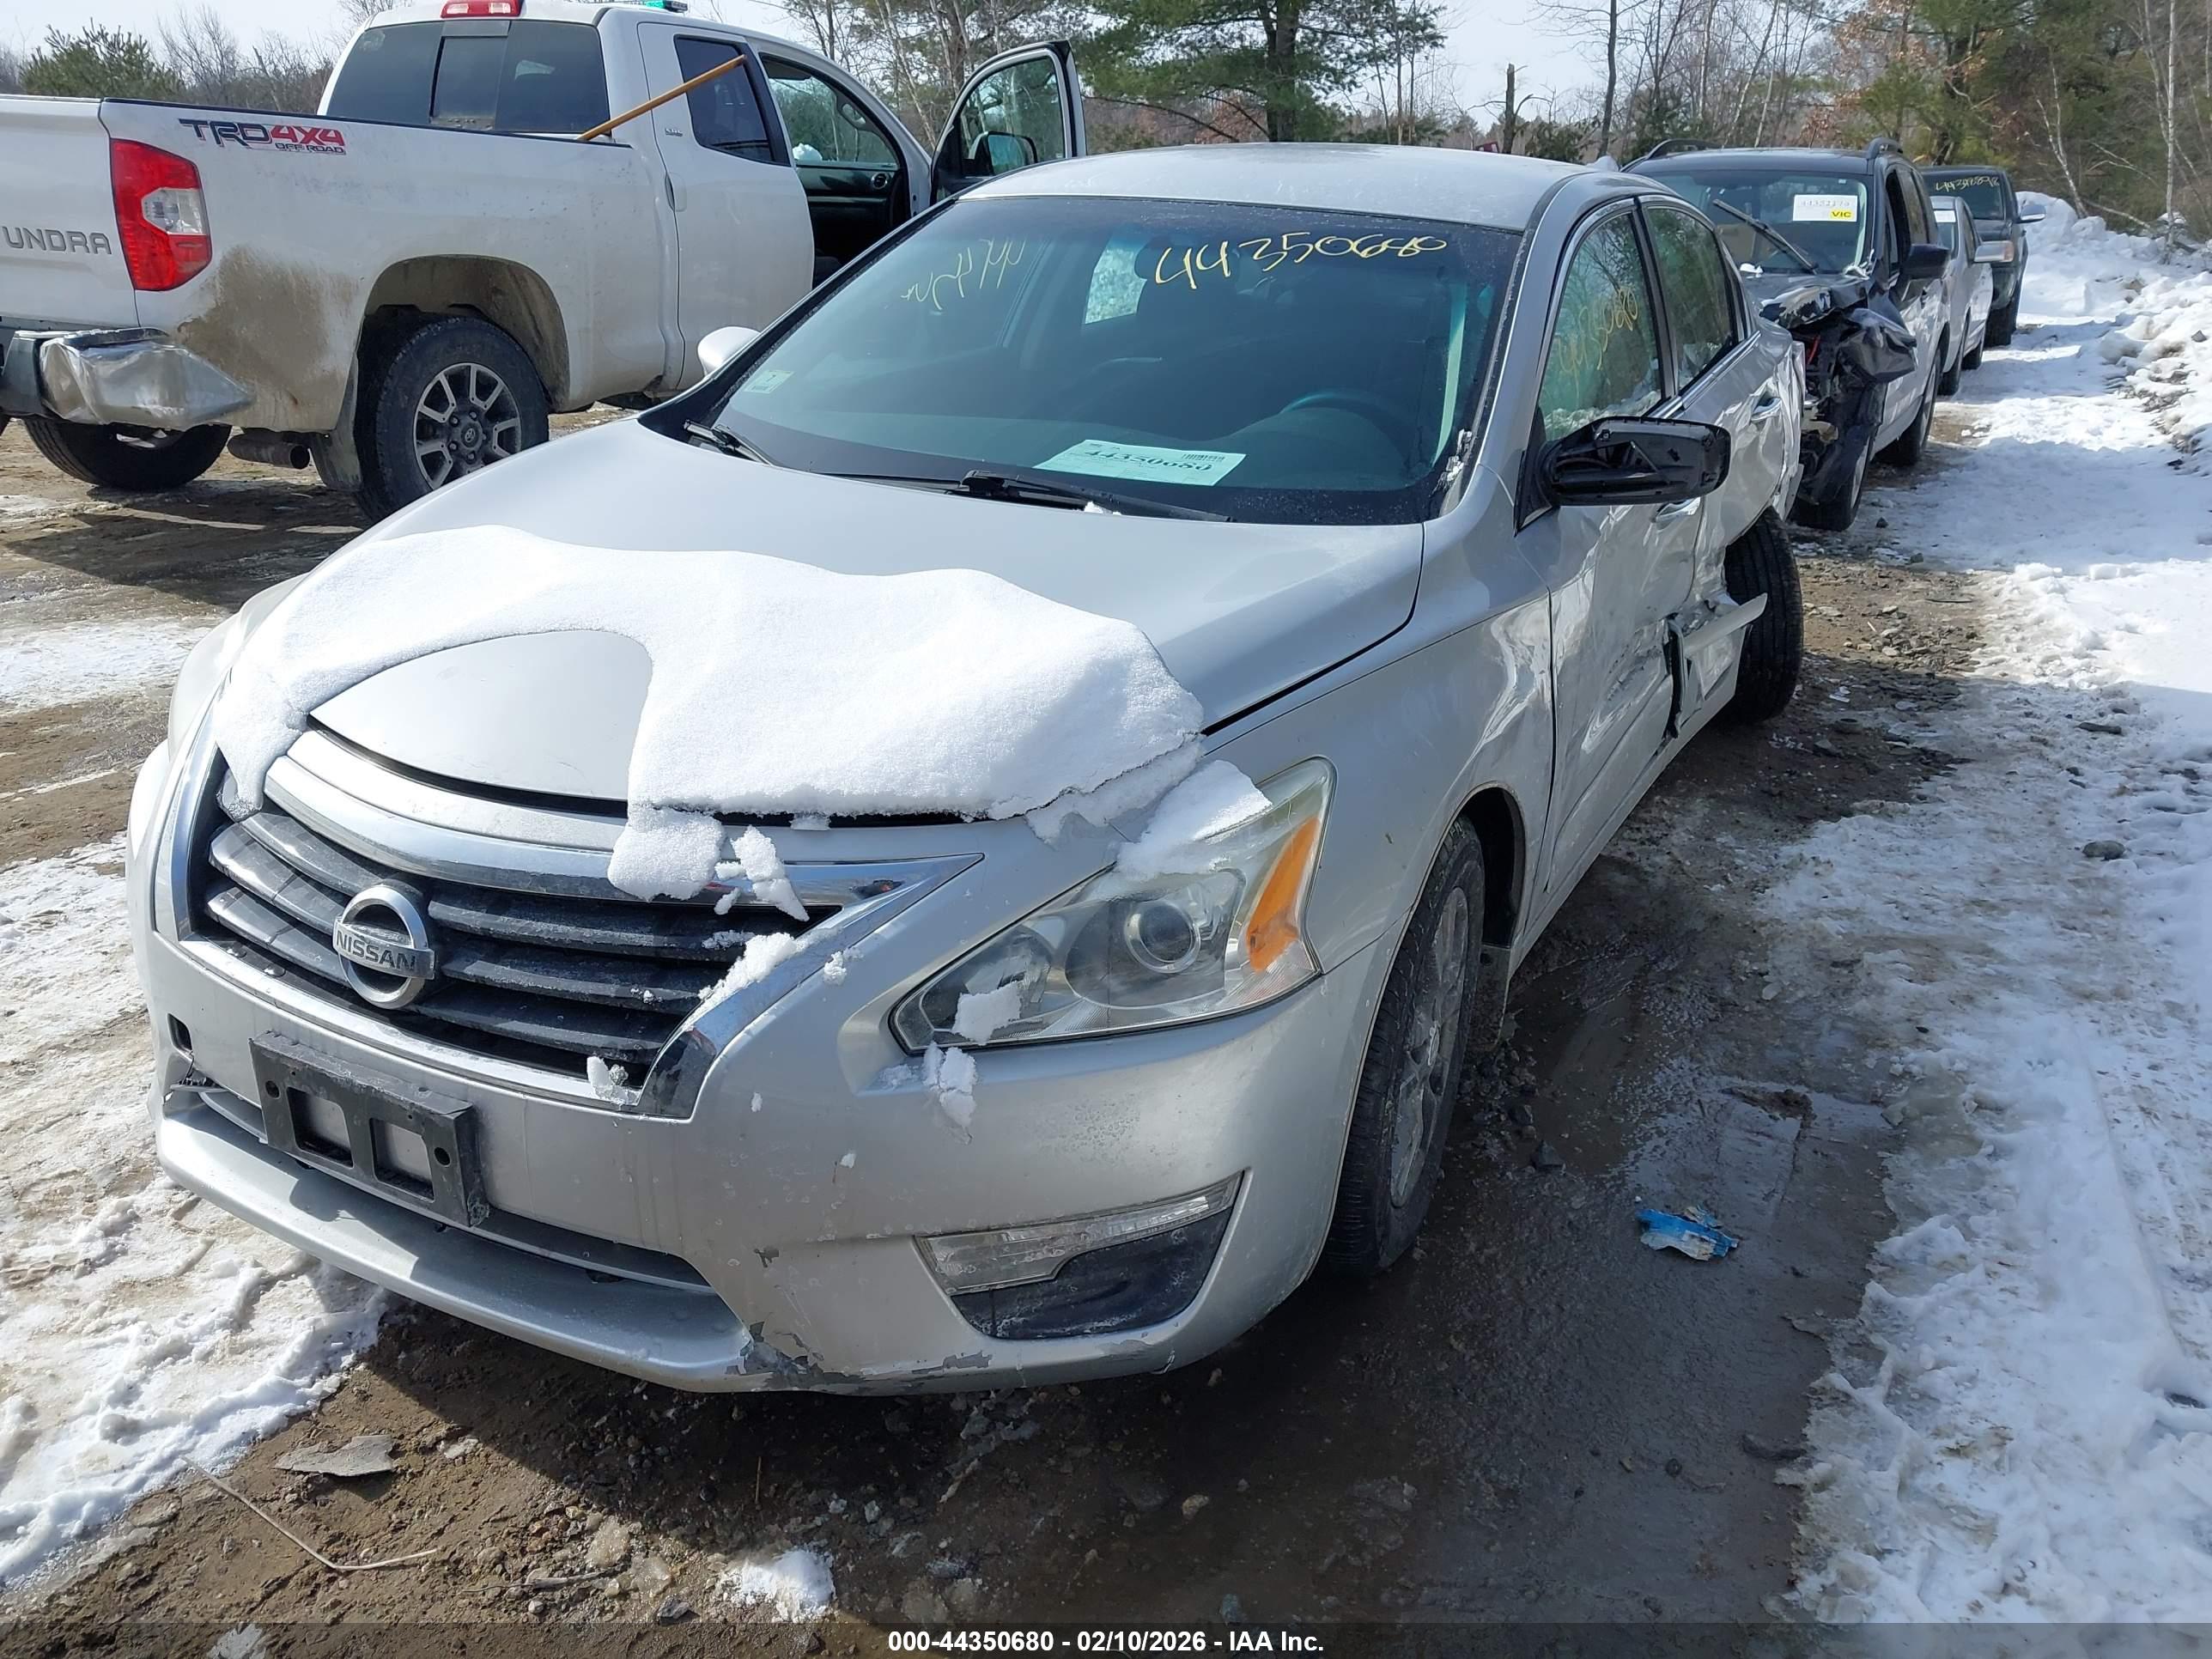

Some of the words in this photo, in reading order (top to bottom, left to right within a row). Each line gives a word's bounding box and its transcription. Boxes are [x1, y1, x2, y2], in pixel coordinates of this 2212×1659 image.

[179, 118, 272, 149] TRD
[275, 143, 304, 151] OFF
[307, 145, 345, 155] ROAD
[2, 226, 112, 254] UNDRA
[336, 930, 416, 971] NISSAN
